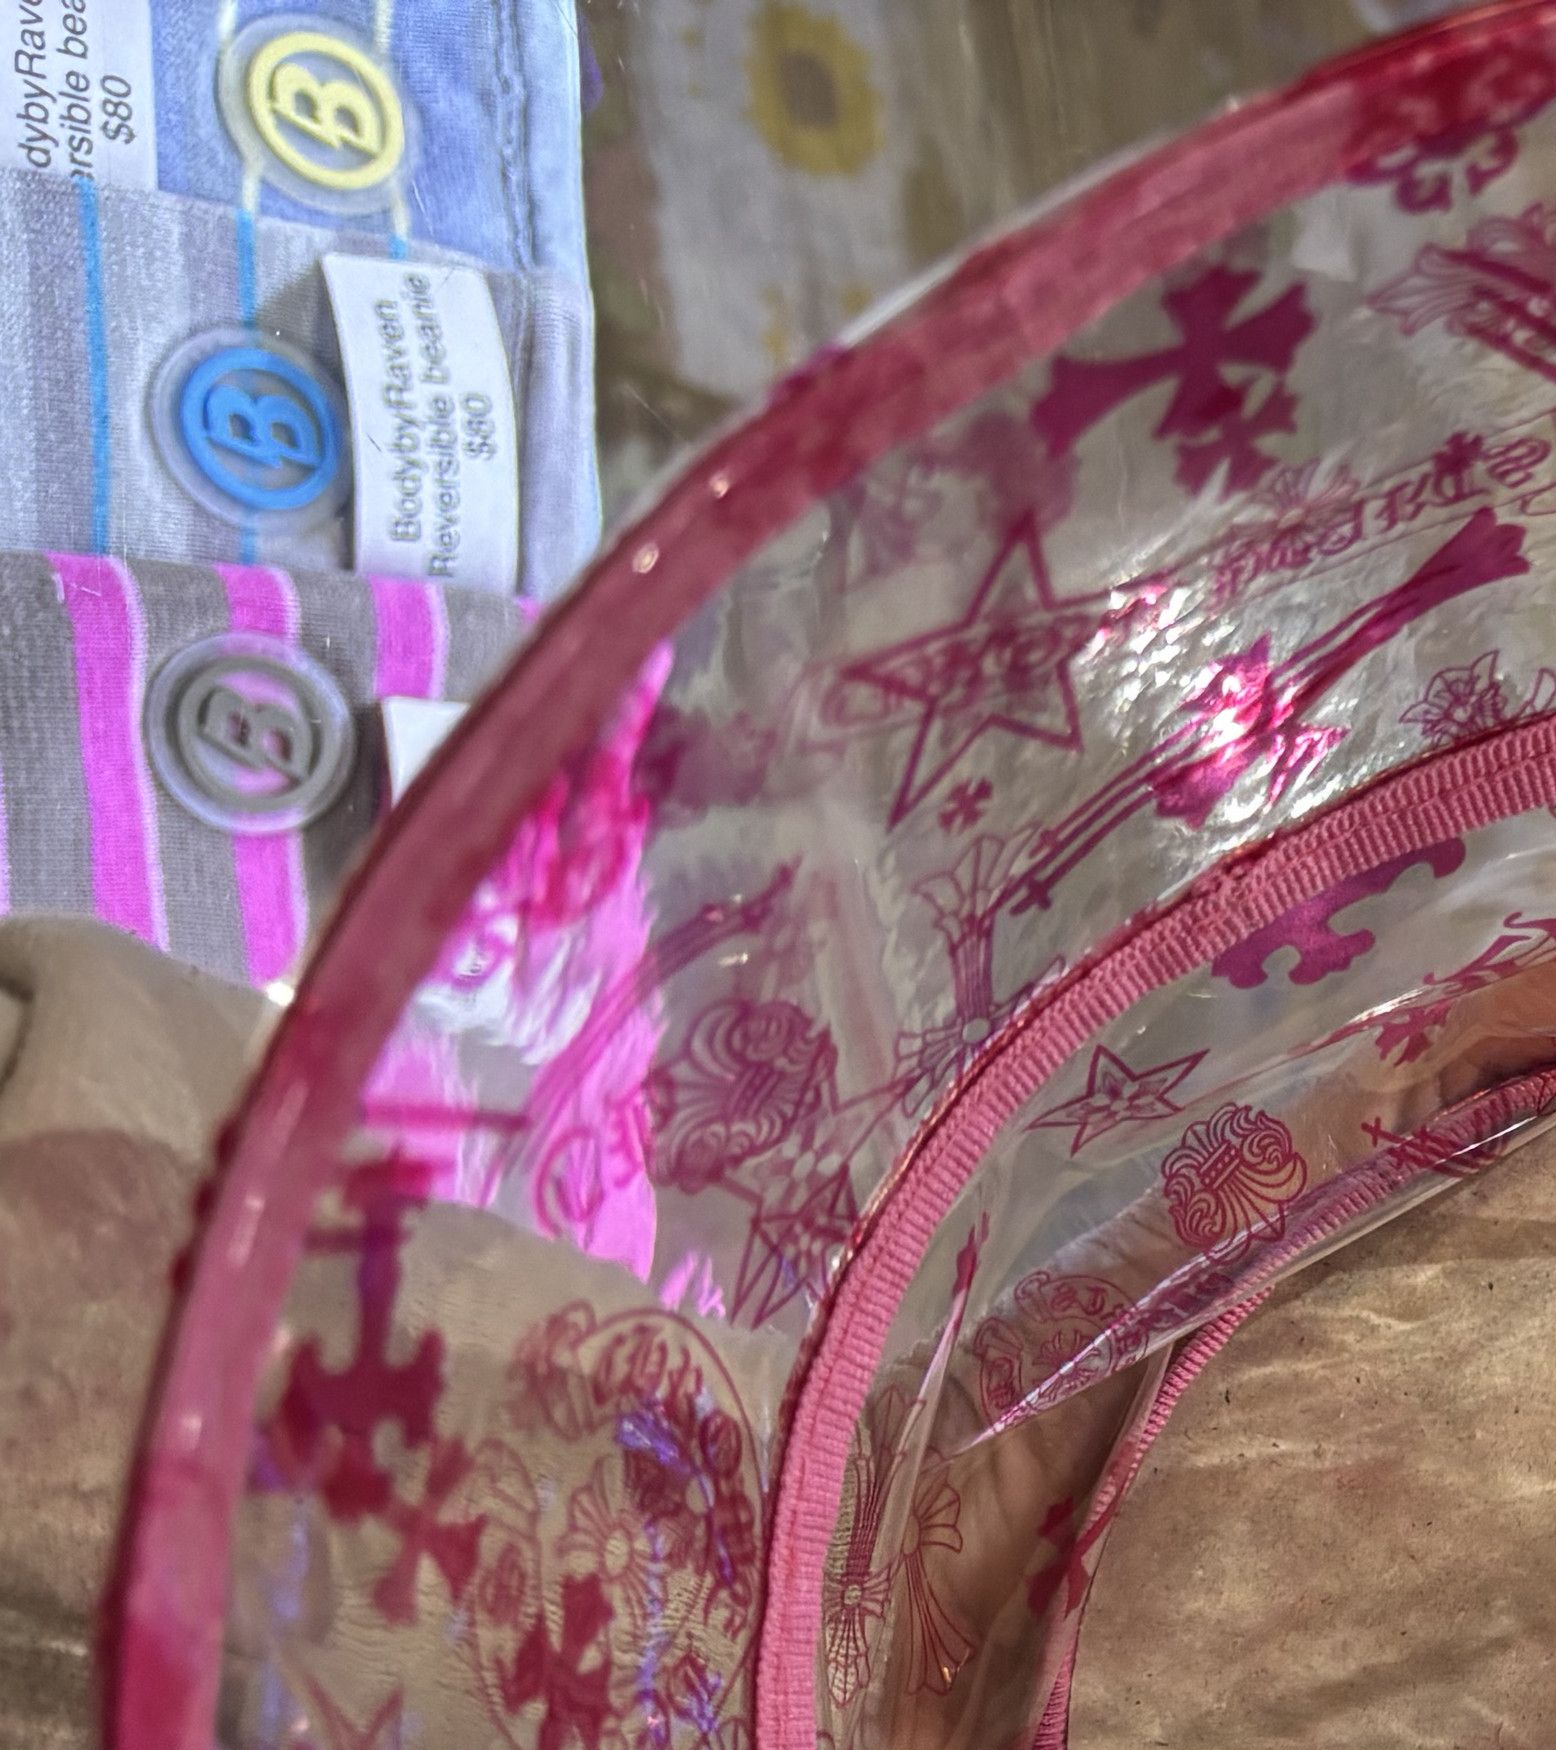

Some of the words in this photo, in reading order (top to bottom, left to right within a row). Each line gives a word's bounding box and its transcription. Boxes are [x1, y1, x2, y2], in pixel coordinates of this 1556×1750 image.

[56, 0, 88, 60] bea
[58, 70, 95, 176] rsible
[99, 74, 136, 145] $80
[404, 273, 450, 387] beanie
[376, 299, 425, 543] BodybyRaven
[425, 394, 461, 577] Reversible
